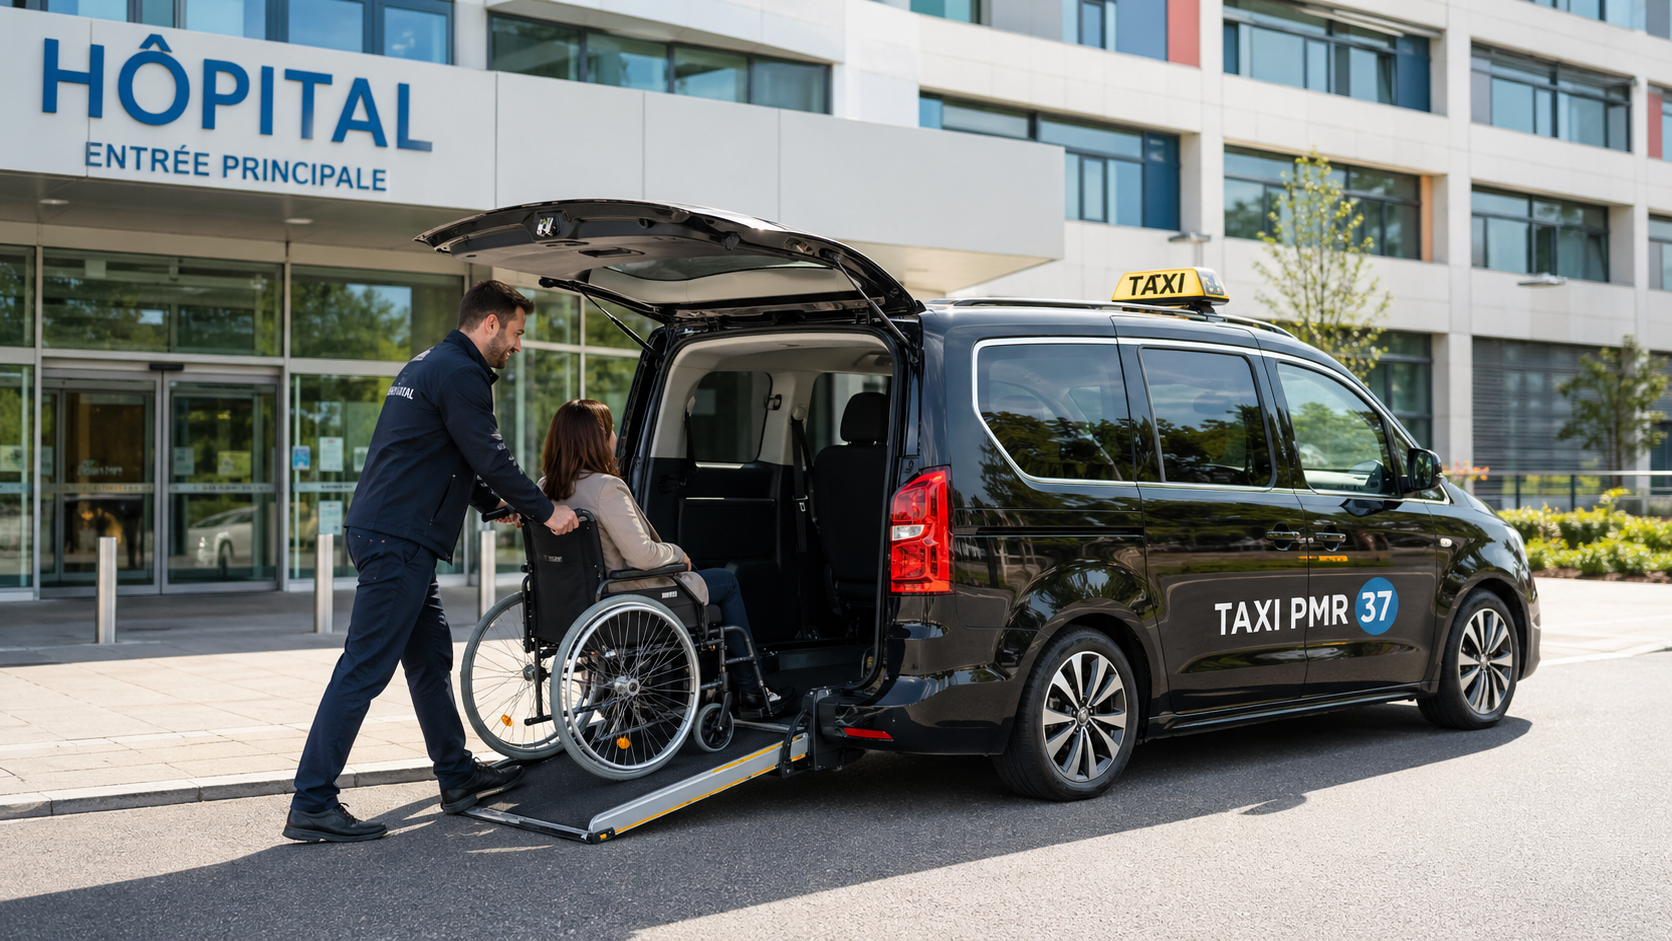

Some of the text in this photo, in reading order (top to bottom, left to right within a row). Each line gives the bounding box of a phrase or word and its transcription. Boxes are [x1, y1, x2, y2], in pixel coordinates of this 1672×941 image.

[42, 33, 433, 152] HÔPITAL
[86, 142, 387, 191] ENTRÉE PRINCIPALE
[1129, 273, 1185, 296] TAXI
[1215, 590, 1393, 636] TAXI PMR 37
